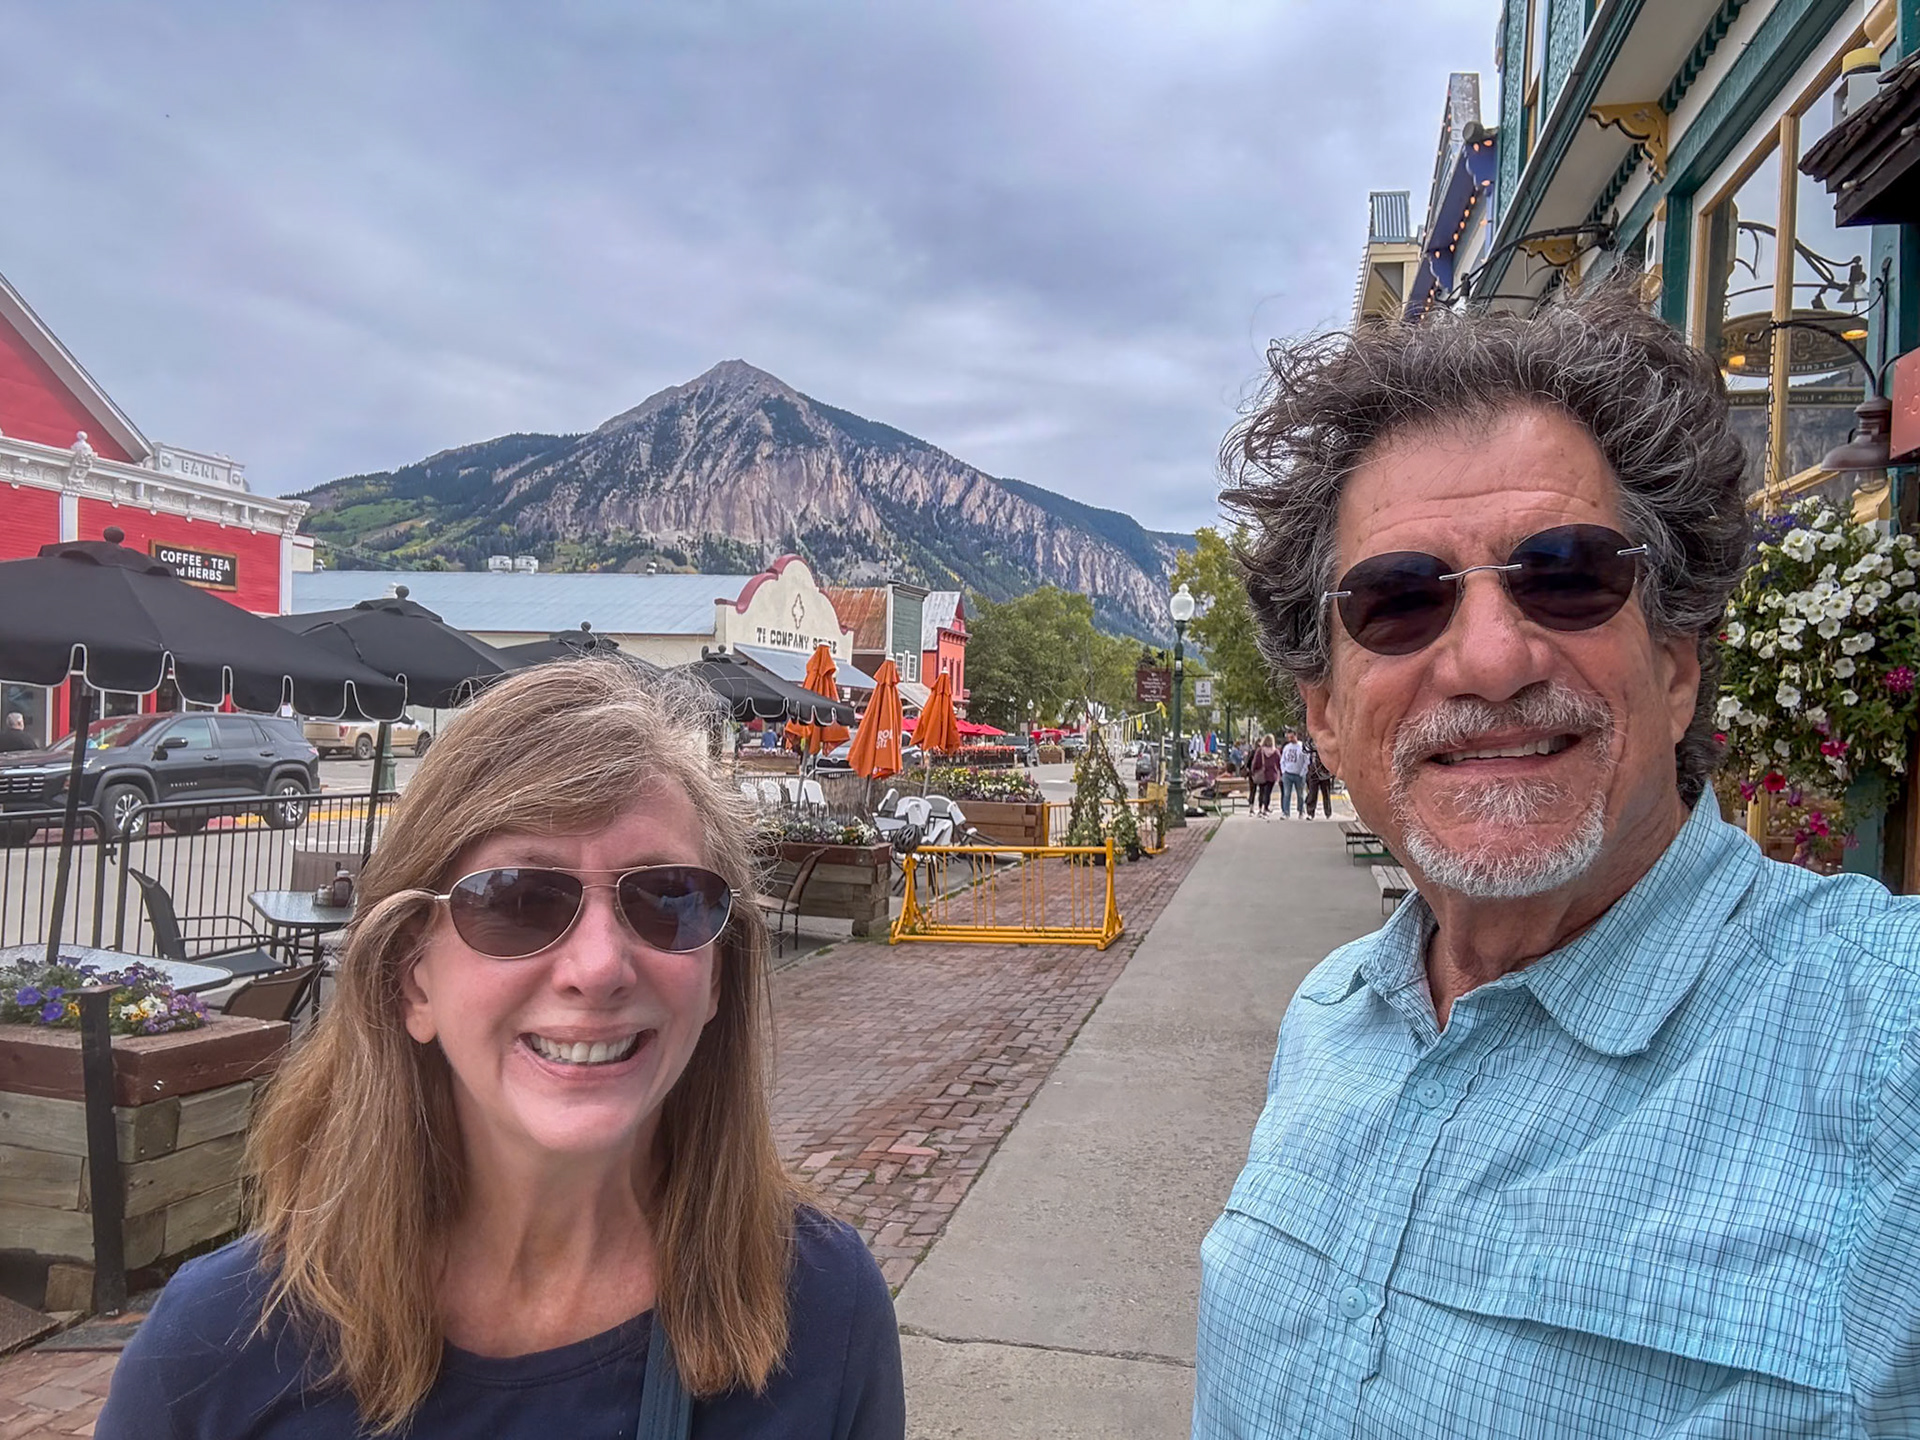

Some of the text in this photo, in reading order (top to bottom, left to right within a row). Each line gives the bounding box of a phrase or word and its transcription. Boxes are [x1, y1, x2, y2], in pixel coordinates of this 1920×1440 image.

[181, 459, 218, 480] BANK
[160, 550, 231, 572] COFFEE TEA
[188, 566, 222, 581] HERBS
[770, 629, 809, 650] COMPANY
